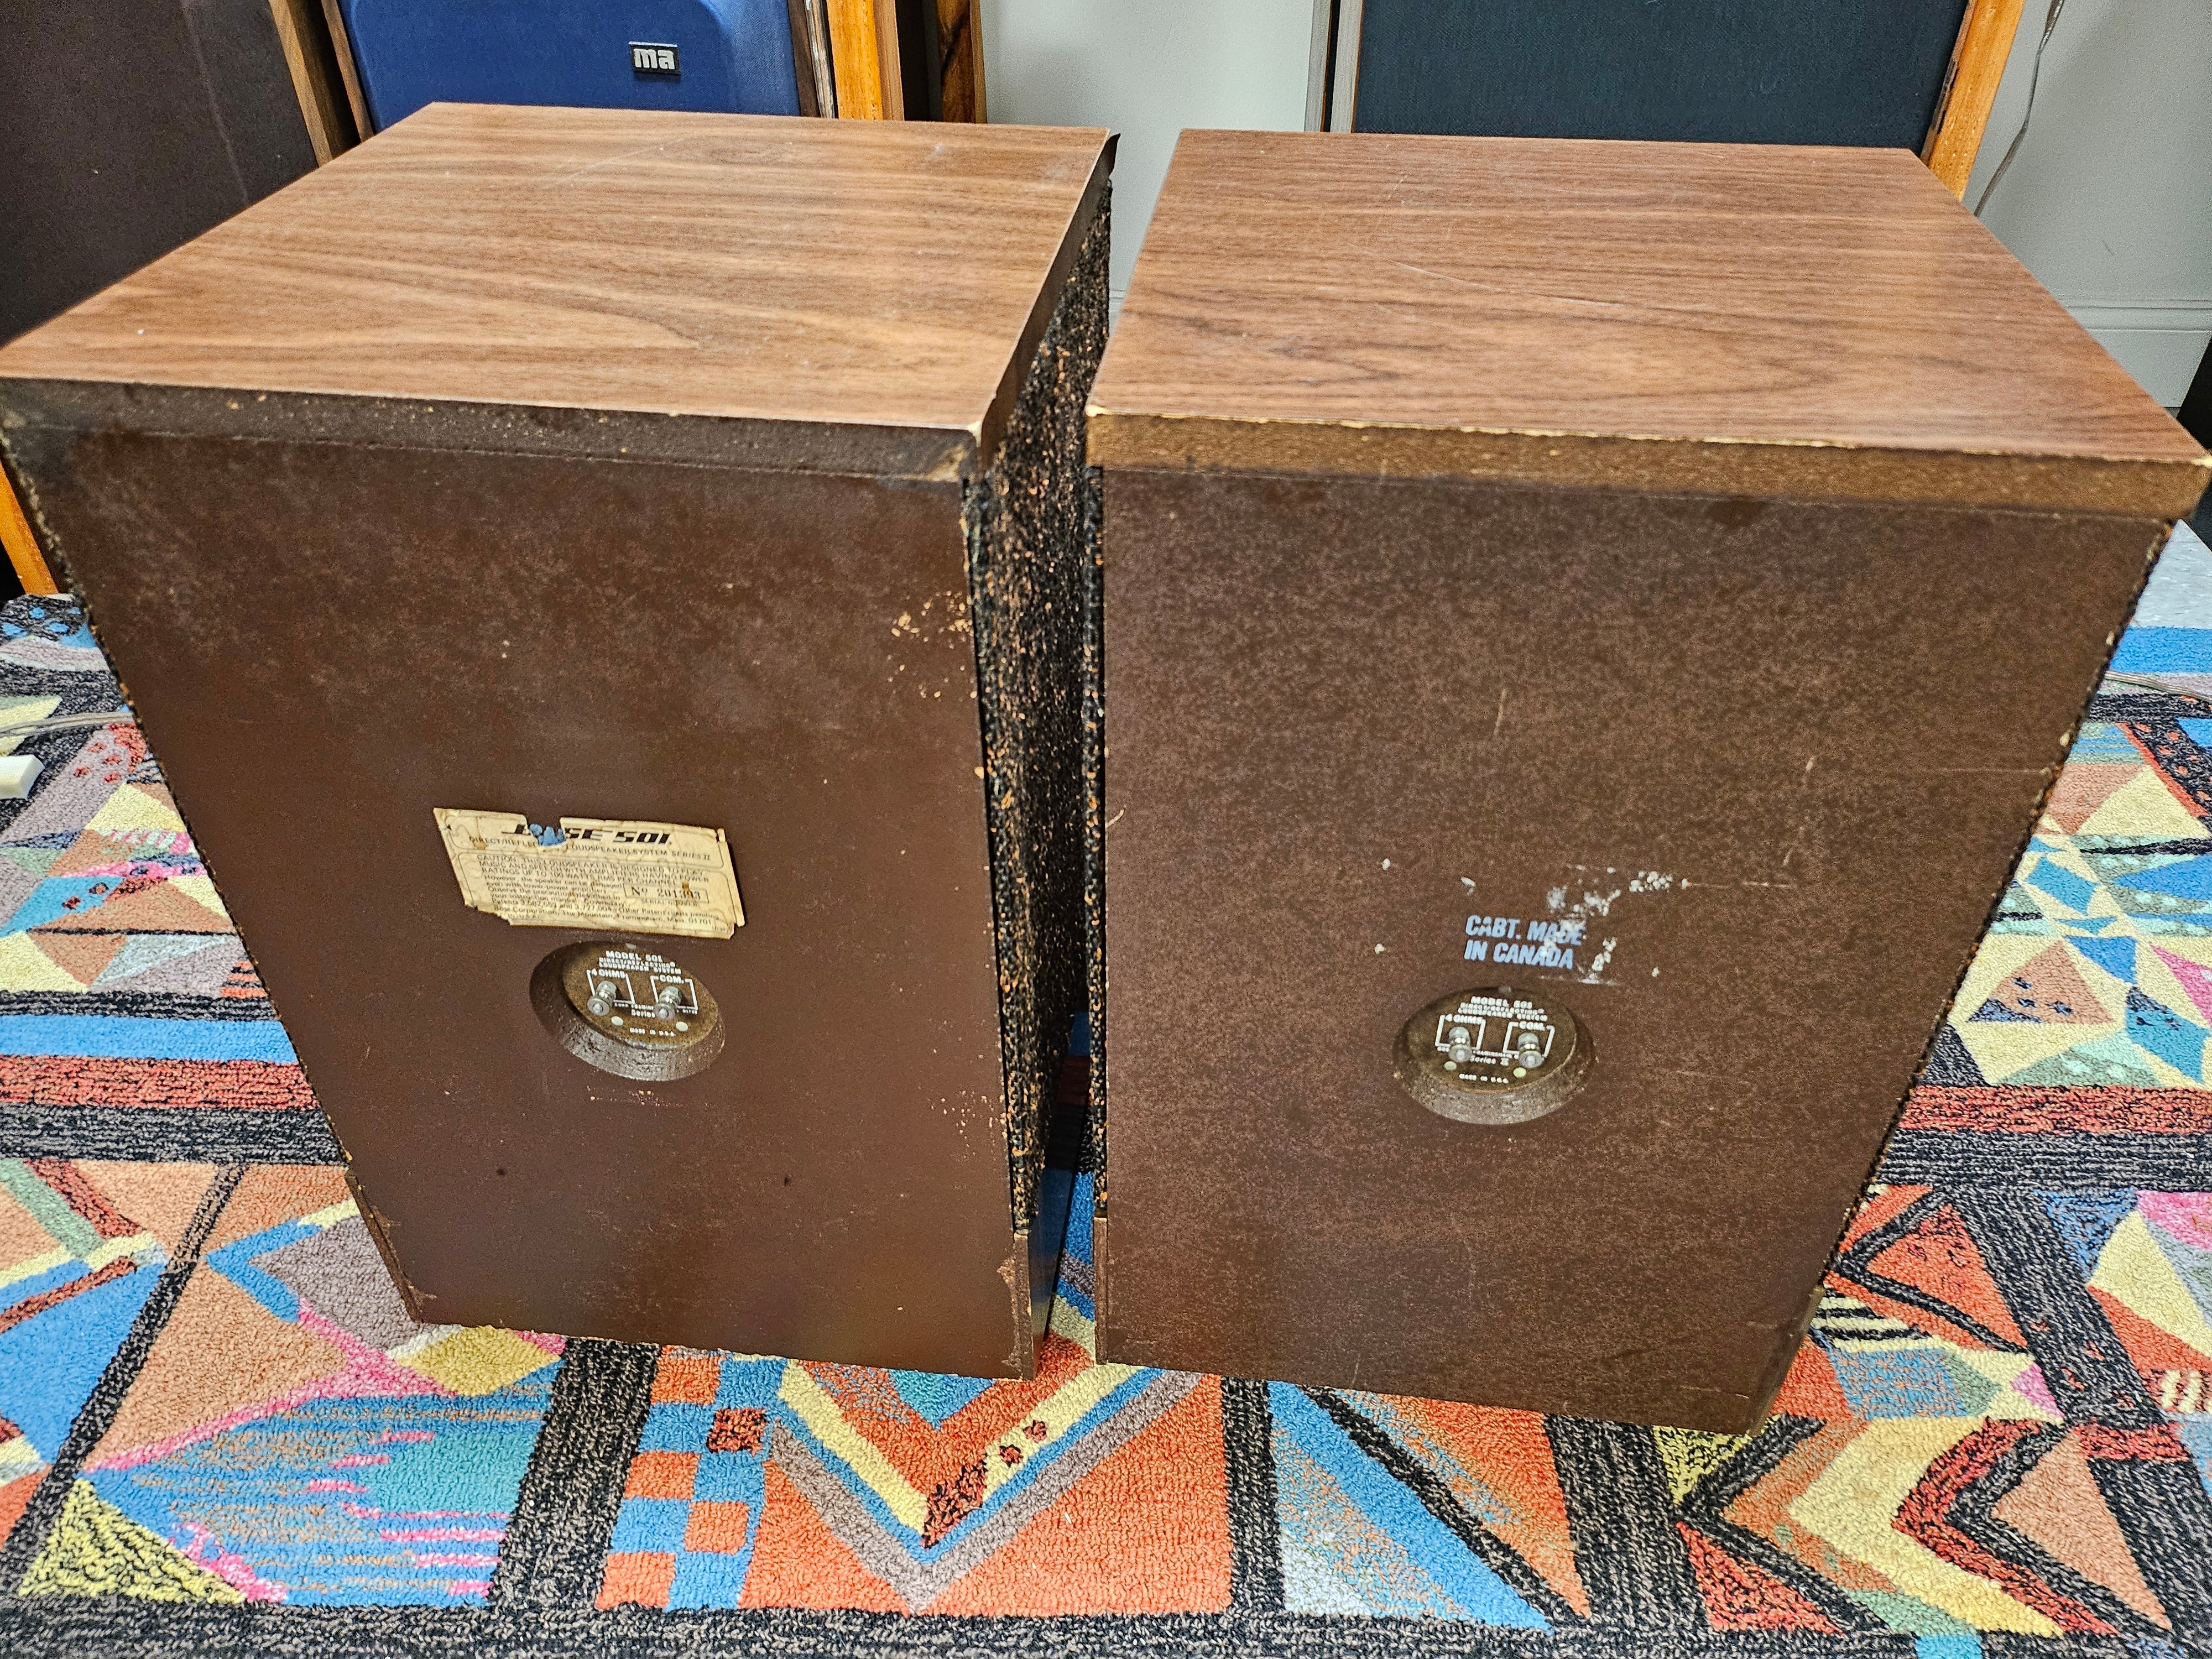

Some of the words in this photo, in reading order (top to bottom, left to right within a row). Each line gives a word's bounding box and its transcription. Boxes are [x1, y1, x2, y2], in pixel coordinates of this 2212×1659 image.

[633, 48, 675, 70] ma
[1465, 914, 1521, 940] CABT.
[606, 950, 641, 961] MODEL
[645, 954, 663, 963] 501
[1464, 939, 1489, 961] IN
[1493, 942, 1574, 970] CANADA
[591, 968, 598, 977] 4
[598, 969, 627, 979] OHMS
[1470, 996, 1509, 1008] MODEL
[1453, 1014, 1483, 1025] OHMS
